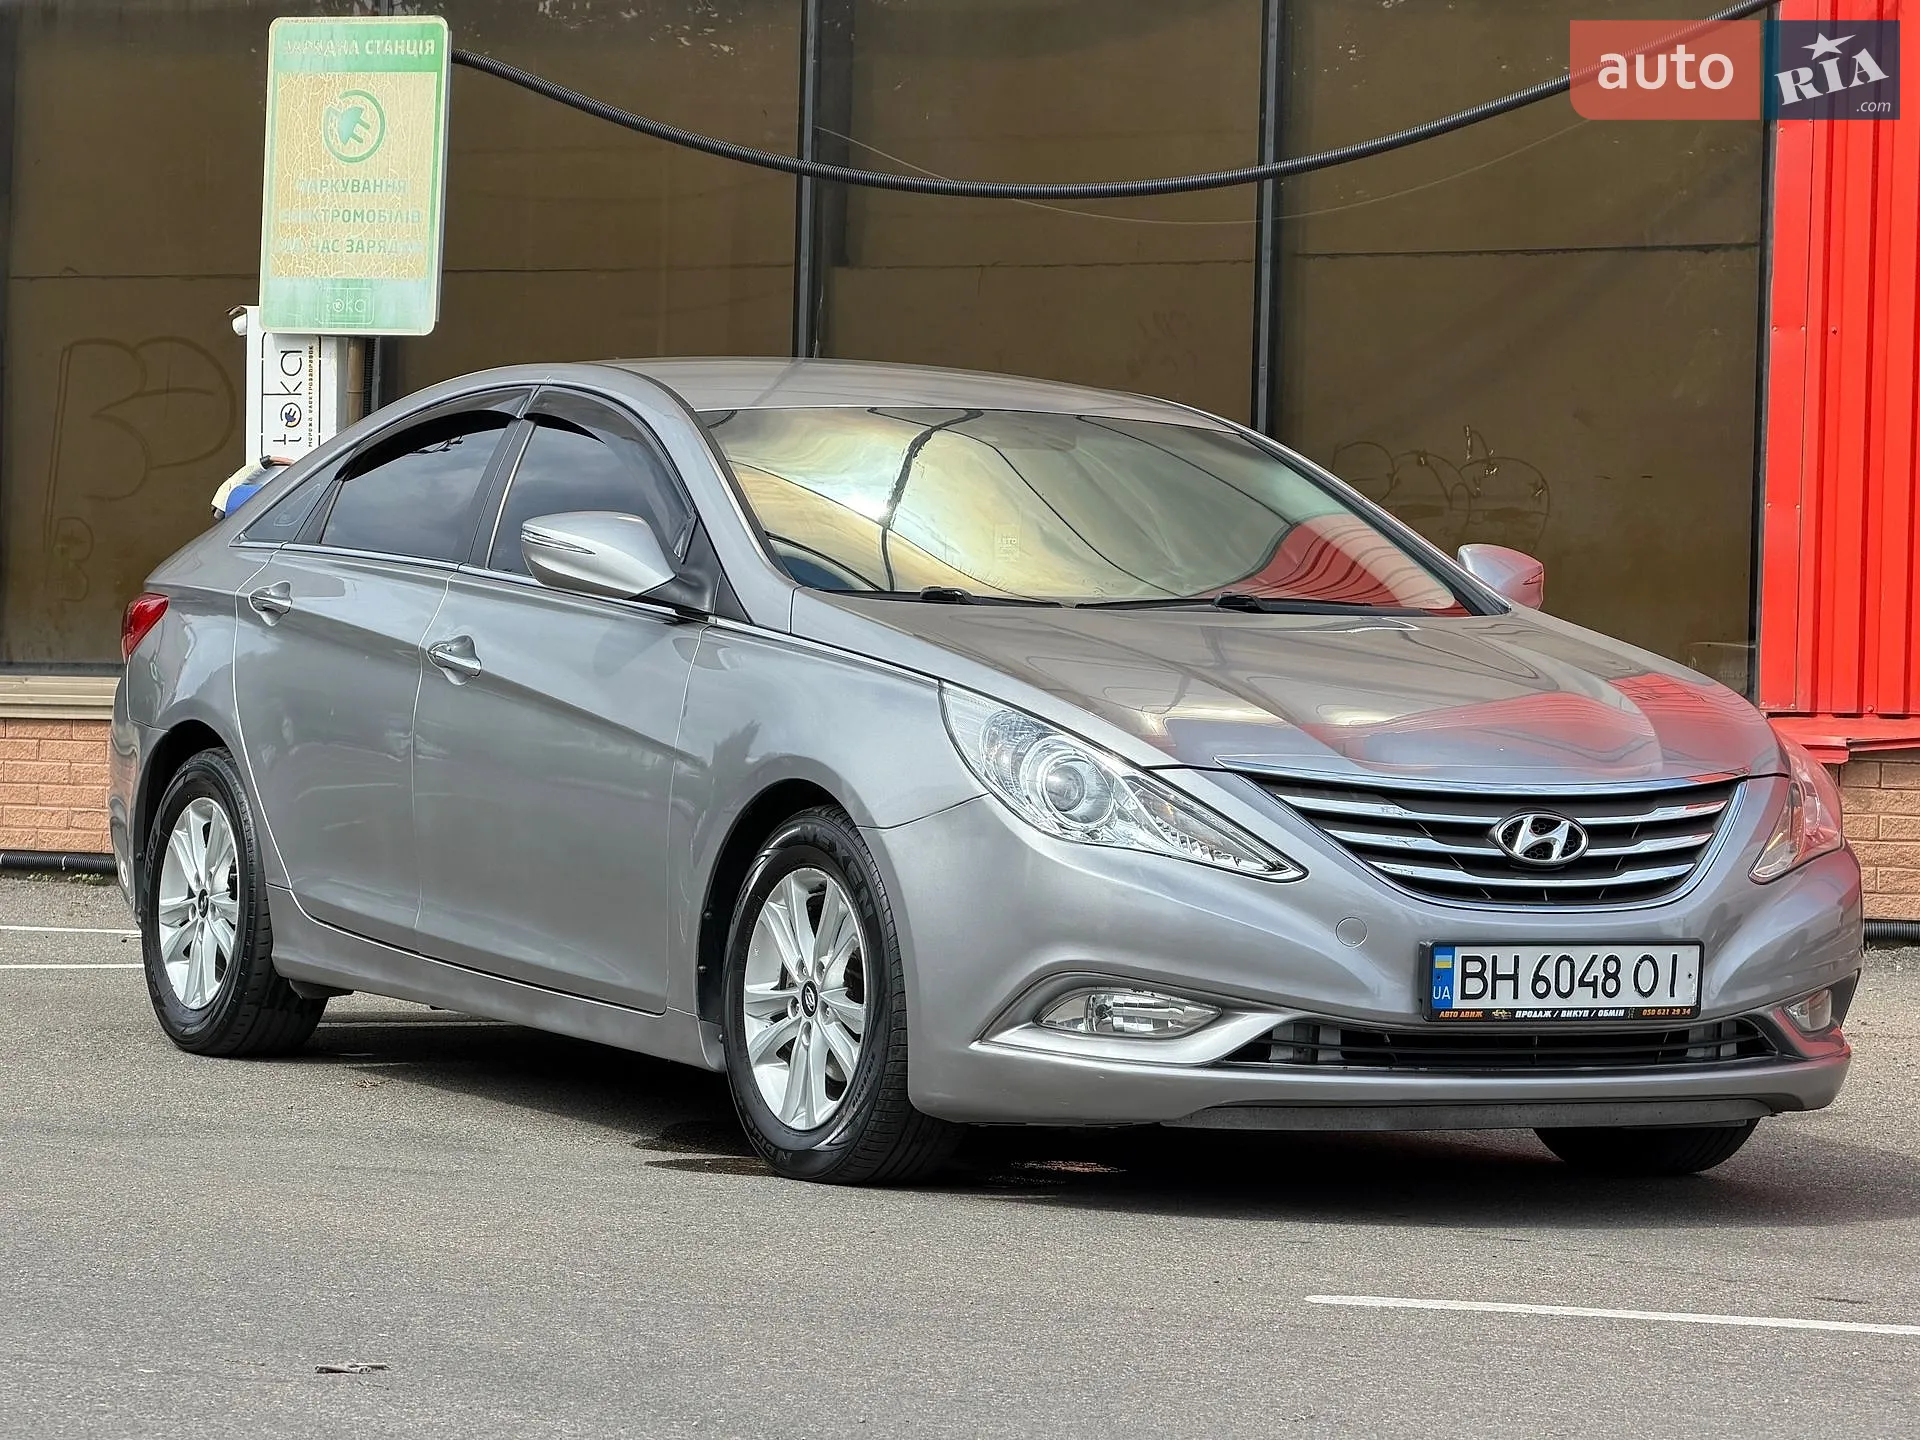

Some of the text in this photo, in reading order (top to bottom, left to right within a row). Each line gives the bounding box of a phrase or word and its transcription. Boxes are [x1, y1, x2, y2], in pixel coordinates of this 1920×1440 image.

[364, 39, 436, 58] СТАНЦІЯ
[1432, 953, 1678, 1001] UA BH 6048 OI
[1439, 1010, 1458, 1018] АВТО
[1515, 1010, 1552, 1018] ПРОДАЖ
[1560, 1009, 1589, 1018] ВИКУП
[1597, 1009, 1625, 1017] ОБМІН
